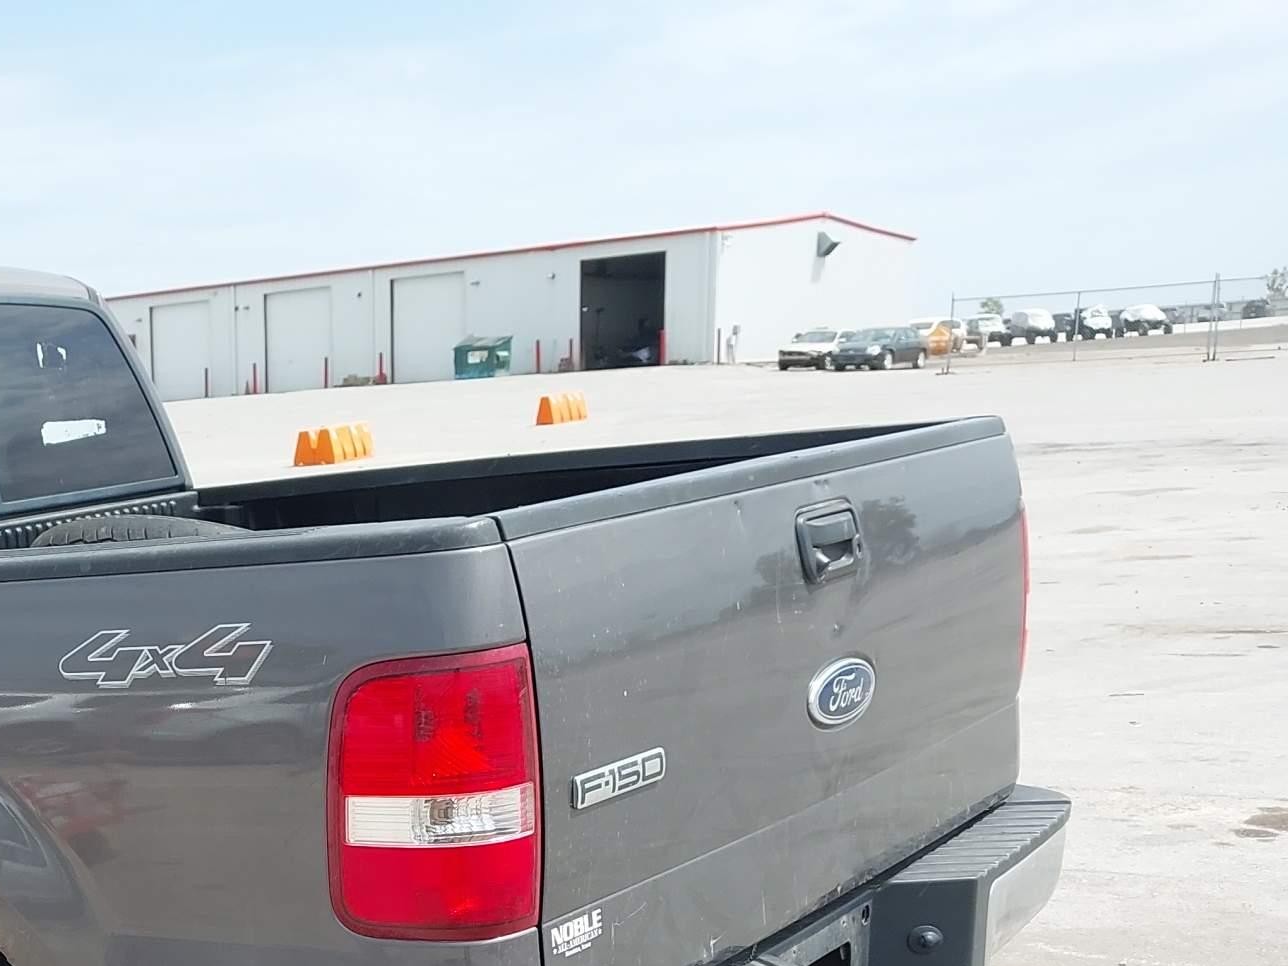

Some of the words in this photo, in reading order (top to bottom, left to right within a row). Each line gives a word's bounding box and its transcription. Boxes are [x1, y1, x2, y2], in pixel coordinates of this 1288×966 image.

[58, 622, 274, 689] 4x4
[829, 672, 864, 712] Ford
[550, 908, 602, 948] NOBLE
